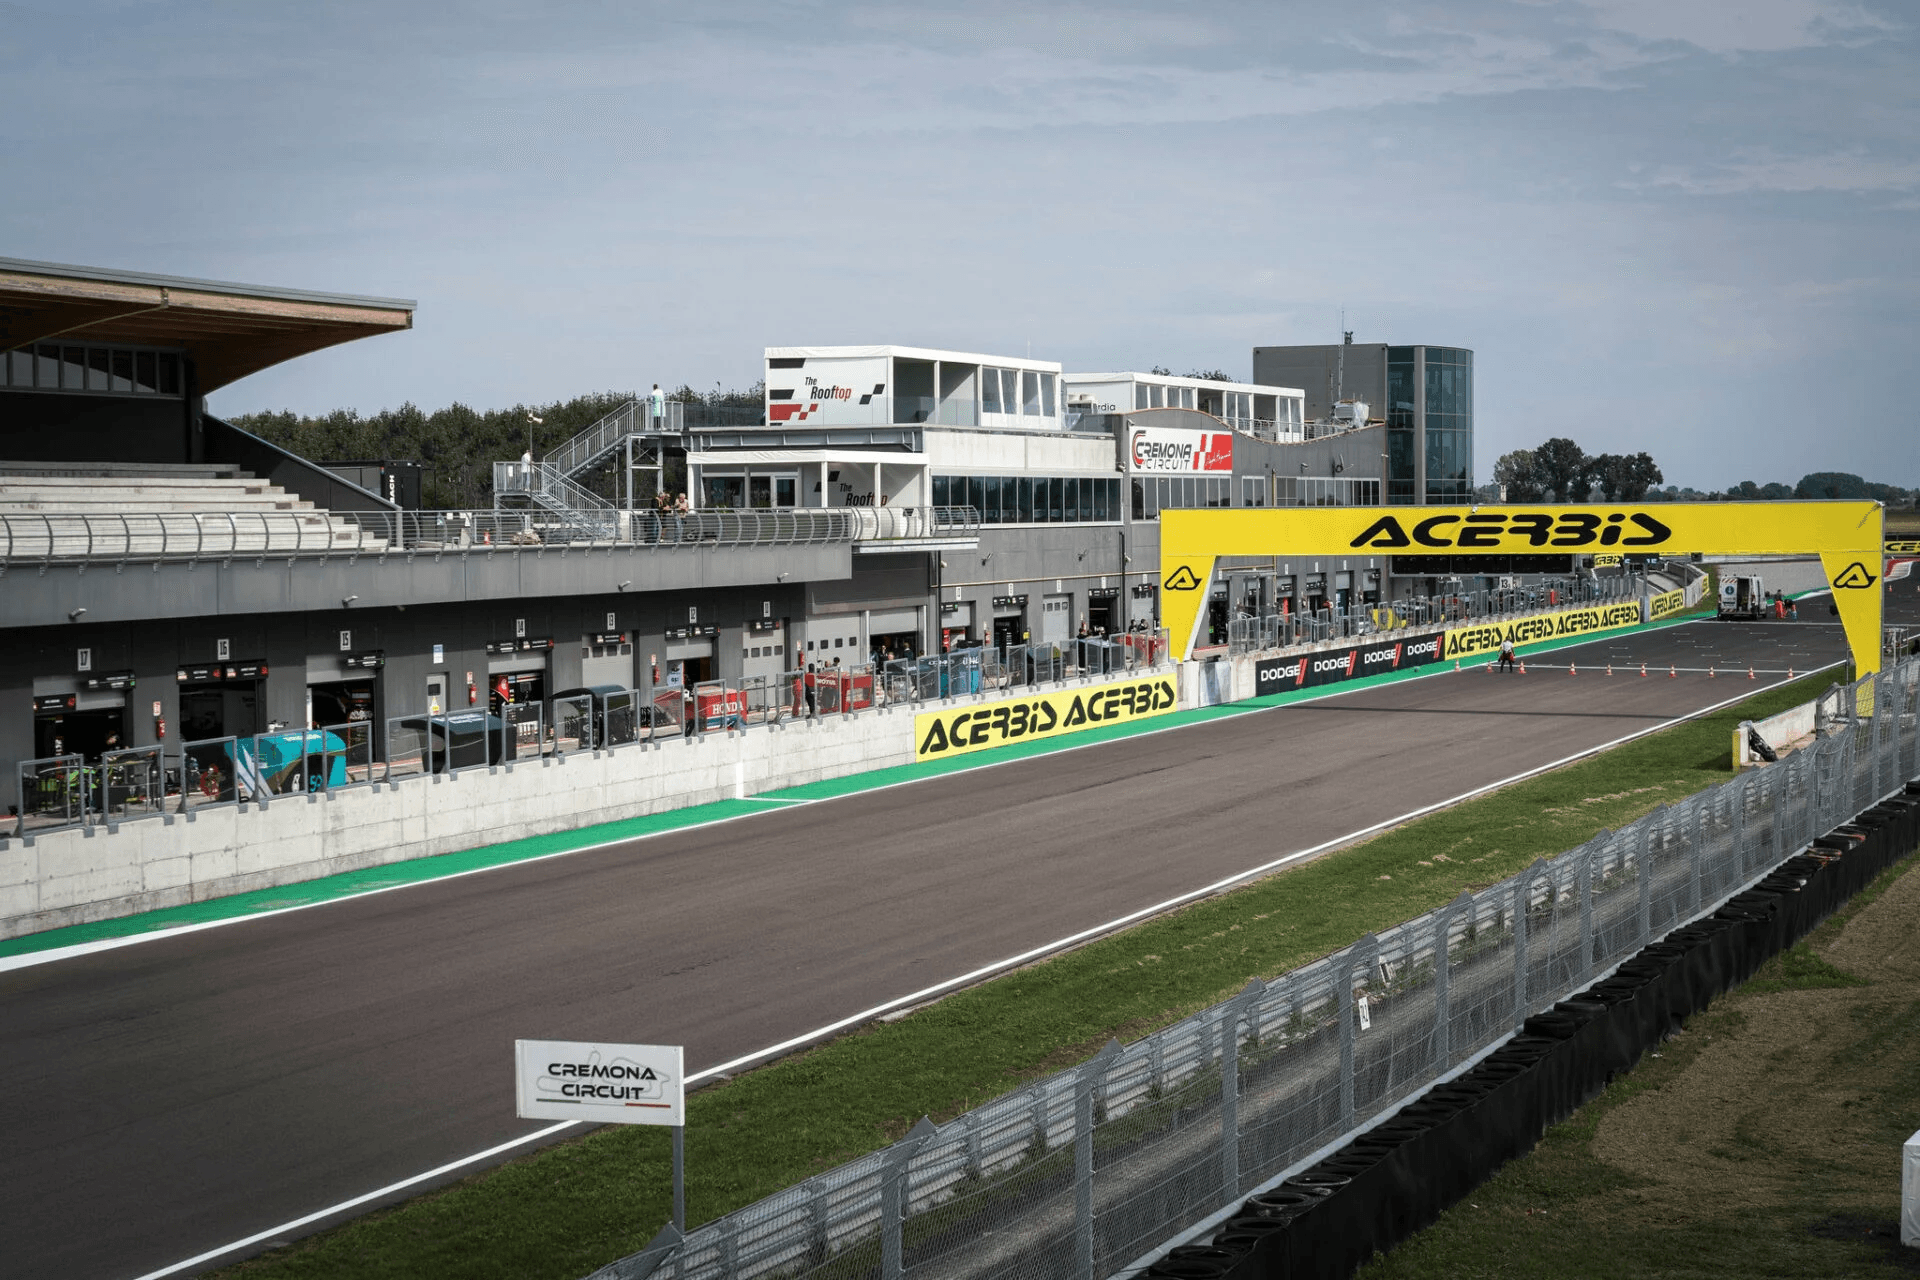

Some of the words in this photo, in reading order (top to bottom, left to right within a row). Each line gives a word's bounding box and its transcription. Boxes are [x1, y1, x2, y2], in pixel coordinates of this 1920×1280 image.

[805, 377, 817, 385] The
[810, 385, 852, 402] Rooftop
[1135, 442, 1192, 459] CREMONA
[1146, 459, 1190, 470] CIRCUIT
[839, 483, 853, 492] The
[845, 492, 888, 507] Rooftp
[343, 633, 348, 646] 15
[219, 641, 227, 655] 16
[80, 650, 88, 666] 17
[1261, 665, 1300, 682] DODGE
[1314, 660, 1350, 672] DODGE
[1364, 652, 1396, 664] DODGE
[1407, 645, 1437, 656] DODGE
[548, 1063, 657, 1081] CREMONA
[561, 1084, 644, 1099] CIRCUIT
